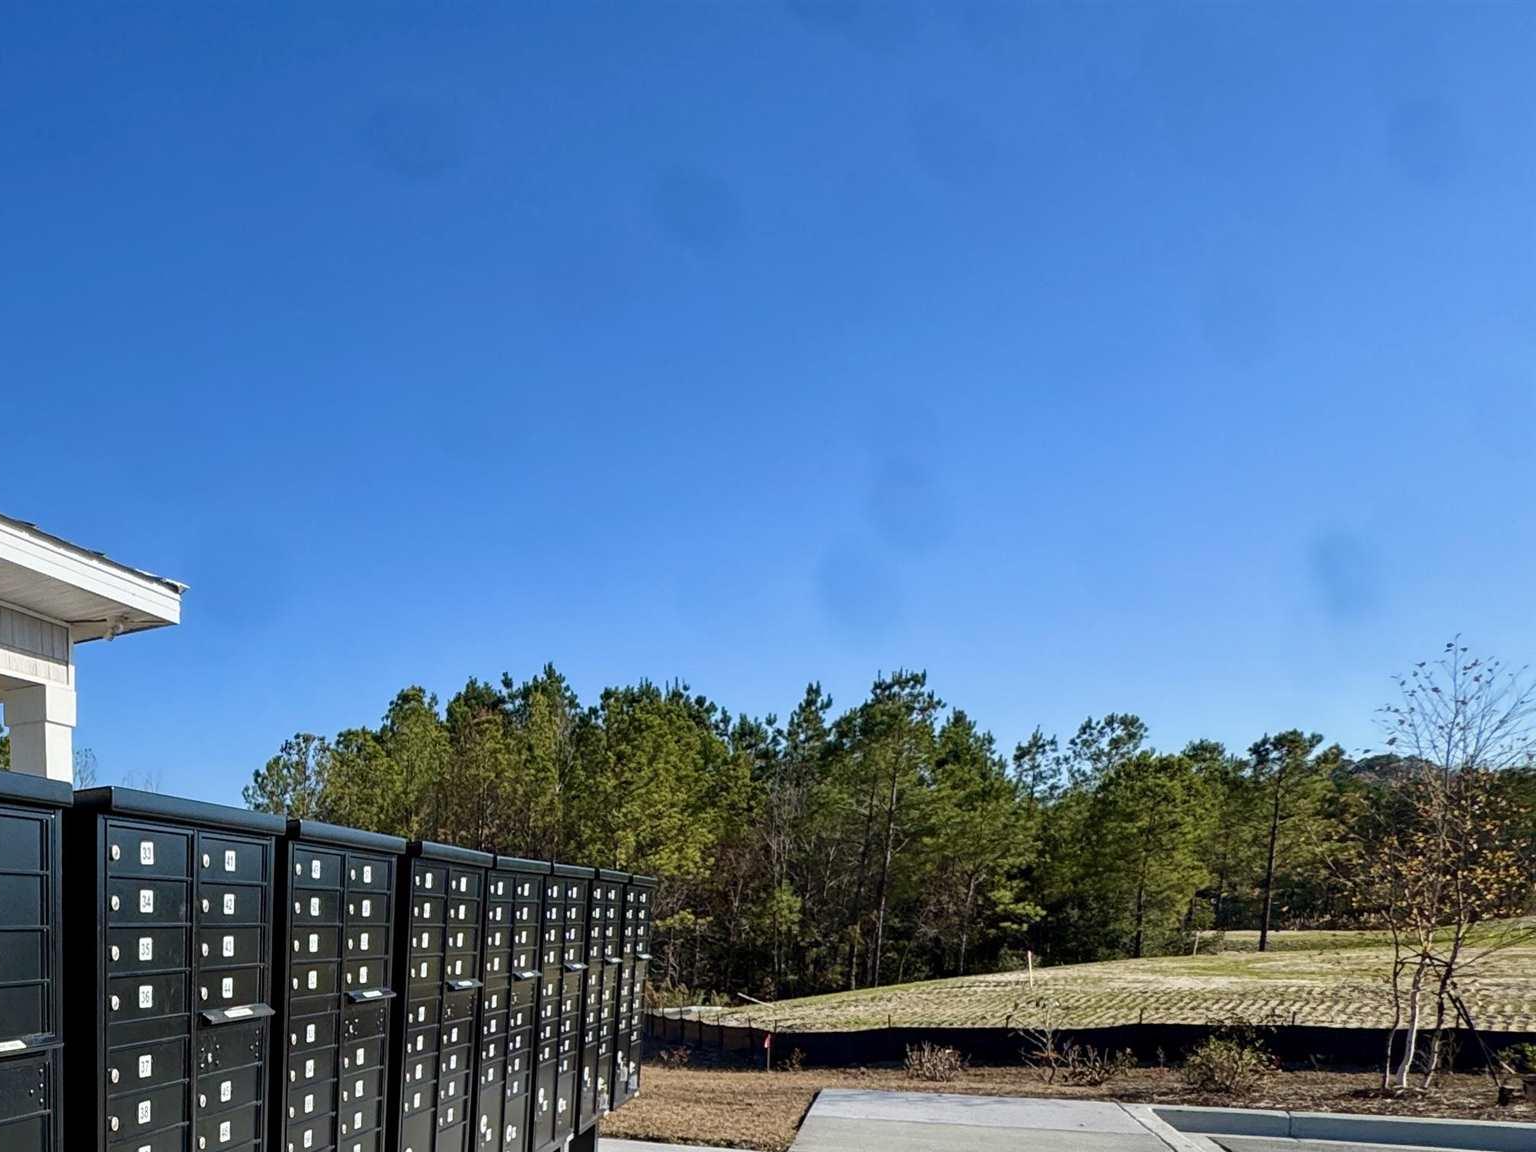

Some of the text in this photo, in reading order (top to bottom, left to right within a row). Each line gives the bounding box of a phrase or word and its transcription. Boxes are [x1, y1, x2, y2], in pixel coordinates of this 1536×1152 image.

[142, 846, 152, 861] 33
[141, 990, 150, 1004] 36
[140, 1106, 149, 1119] 38
